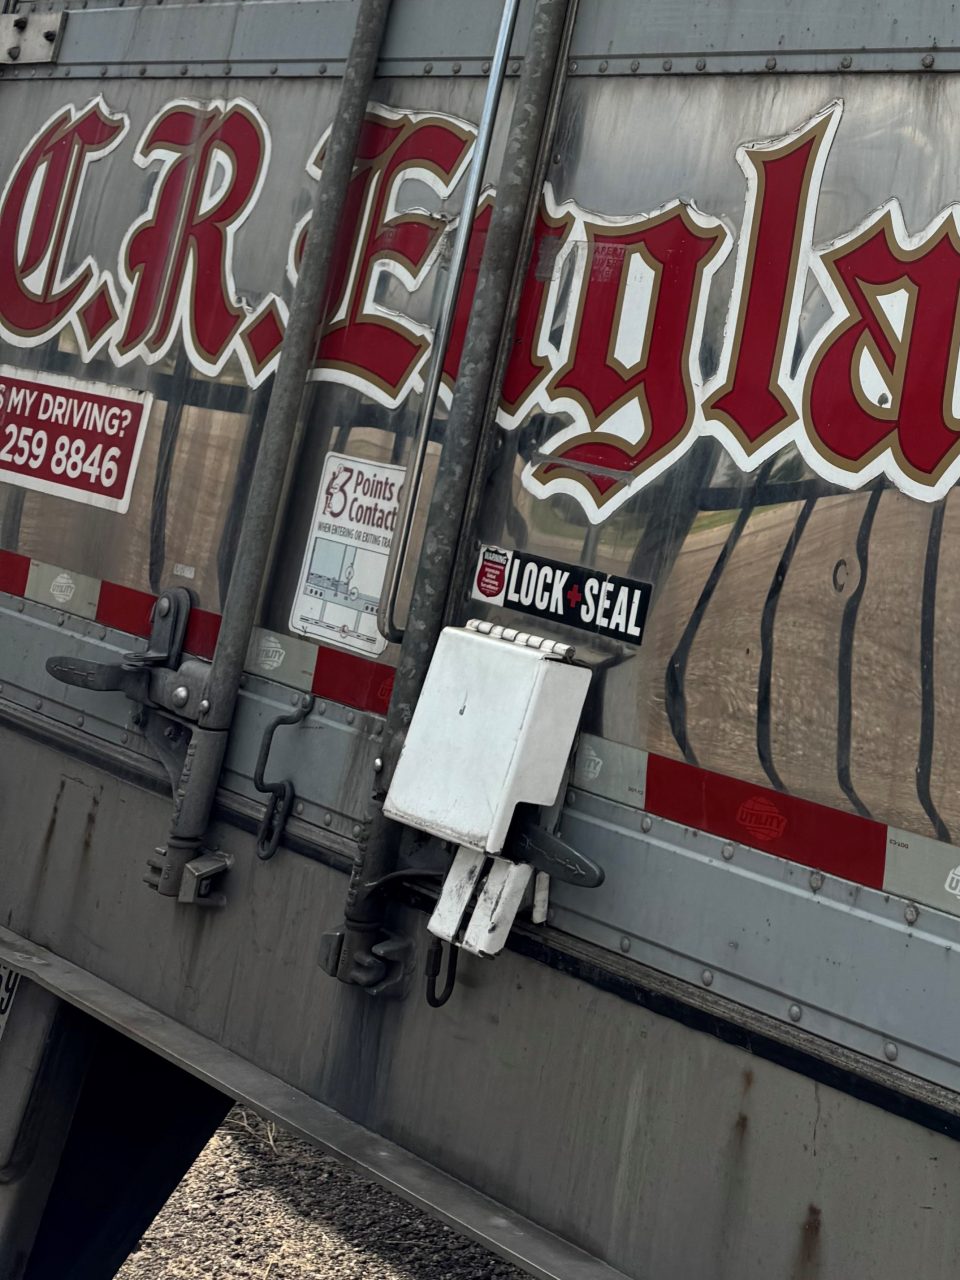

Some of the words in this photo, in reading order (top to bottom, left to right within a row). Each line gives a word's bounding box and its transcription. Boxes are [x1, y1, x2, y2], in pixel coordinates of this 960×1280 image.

[6, 386, 38, 417] MY
[37, 392, 132, 438] DRIVING?
[0, 423, 48, 469] 259
[50, 435, 122, 488] 8846
[353, 470, 395, 501] Points
[348, 497, 397, 532] Contact
[507, 558, 570, 615] LOCK
[580, 577, 642, 637] SEAL
